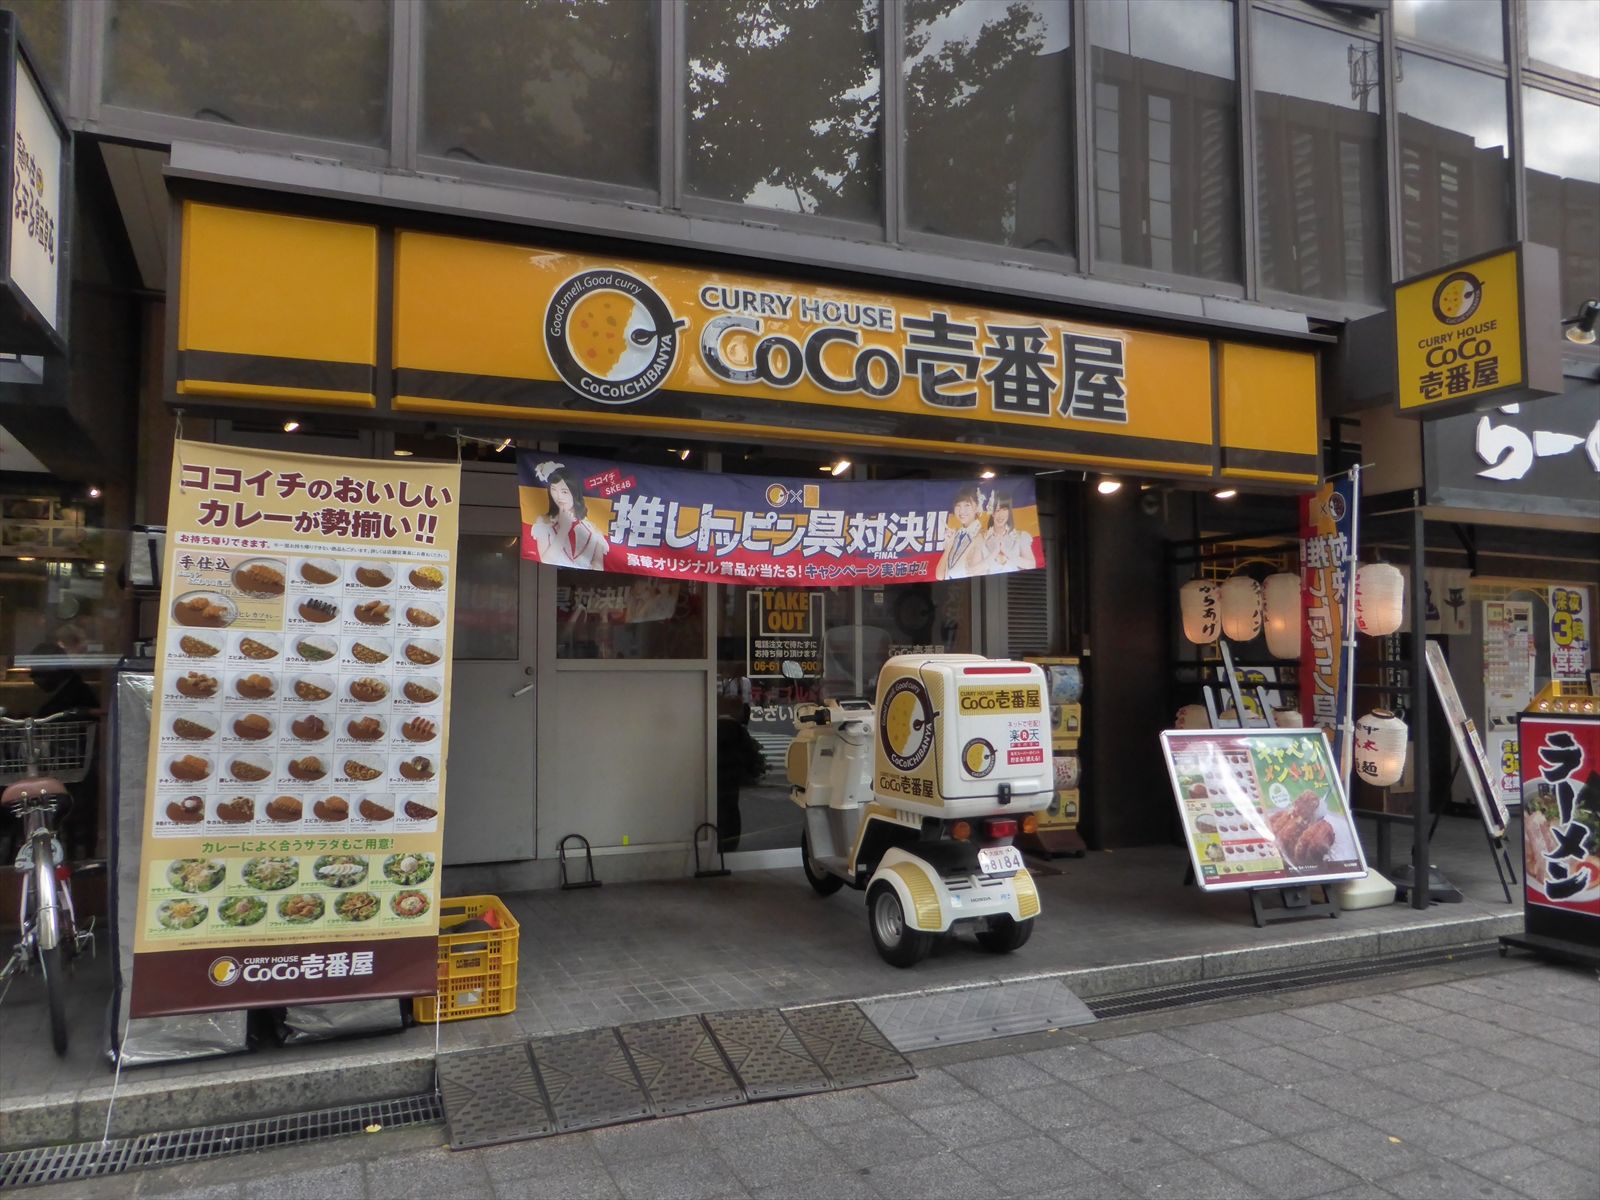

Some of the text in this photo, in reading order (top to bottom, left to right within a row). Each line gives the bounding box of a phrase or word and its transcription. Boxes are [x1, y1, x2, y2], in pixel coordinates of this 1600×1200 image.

[550, 304, 565, 337] Good
[584, 274, 613, 288] Good
[614, 277, 643, 295] curry
[700, 285, 895, 331] CURRY HOUSE
[1418, 319, 1498, 350] CURRY HOUSE
[1425, 337, 1492, 369] CoCo
[580, 334, 673, 398] CoCoICHIBANYA
[1419, 355, 1499, 400] 壱番屋
[180, 463, 453, 508] ココイチのおいしい
[589, 472, 617, 488] ココイチ
[605, 480, 632, 496] SKE48
[179, 533, 271, 550] お持ち帰りできます。
[179, 555, 231, 572] 手仕込
[873, 551, 899, 560] FINAL
[763, 591, 810, 611] TAKE
[1200, 584, 1218, 638] からあげ
[768, 611, 806, 631] OUT
[1538, 732, 1590, 900] ラーメン
[990, 855, 1020, 871] 8184
[243, 955, 299, 965] CURRY HOUSE
